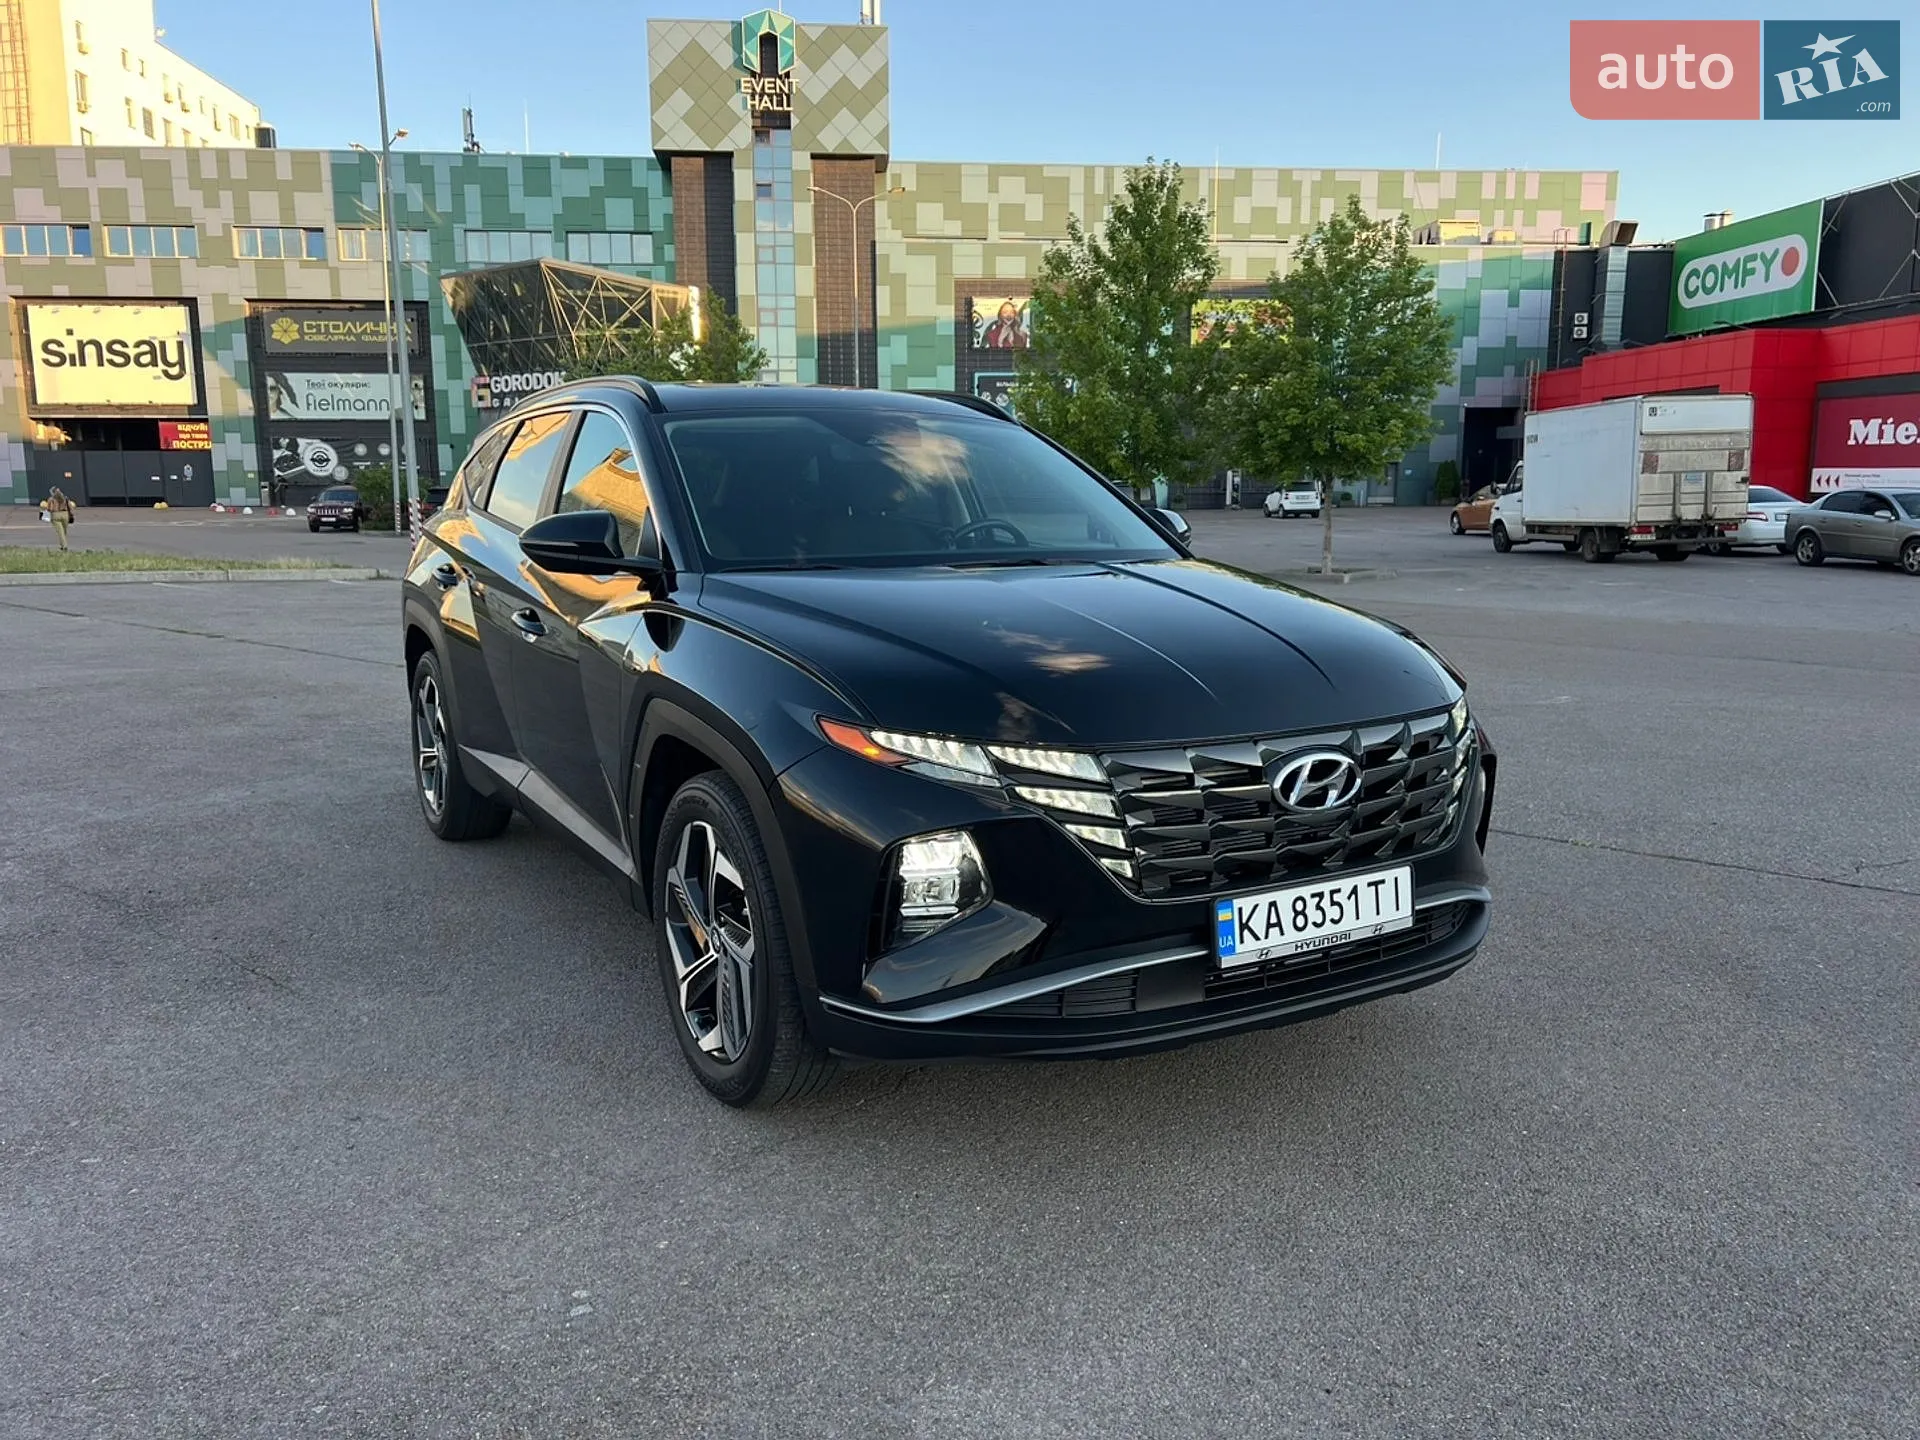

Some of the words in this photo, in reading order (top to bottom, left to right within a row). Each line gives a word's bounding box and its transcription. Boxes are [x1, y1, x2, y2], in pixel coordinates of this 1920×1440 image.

[741, 77, 800, 94] EVENT
[746, 95, 794, 111] HALL
[1683, 247, 1780, 299] COMFY
[41, 328, 187, 381] sinsay
[490, 371, 567, 394] GORODOK
[306, 392, 390, 412] fielmann
[1237, 900, 1285, 945] KA
[1292, 884, 1360, 932] 8351
[1367, 876, 1400, 916] TI
[1219, 935, 1235, 948] UA
[1294, 932, 1351, 952] HYUNDAI
